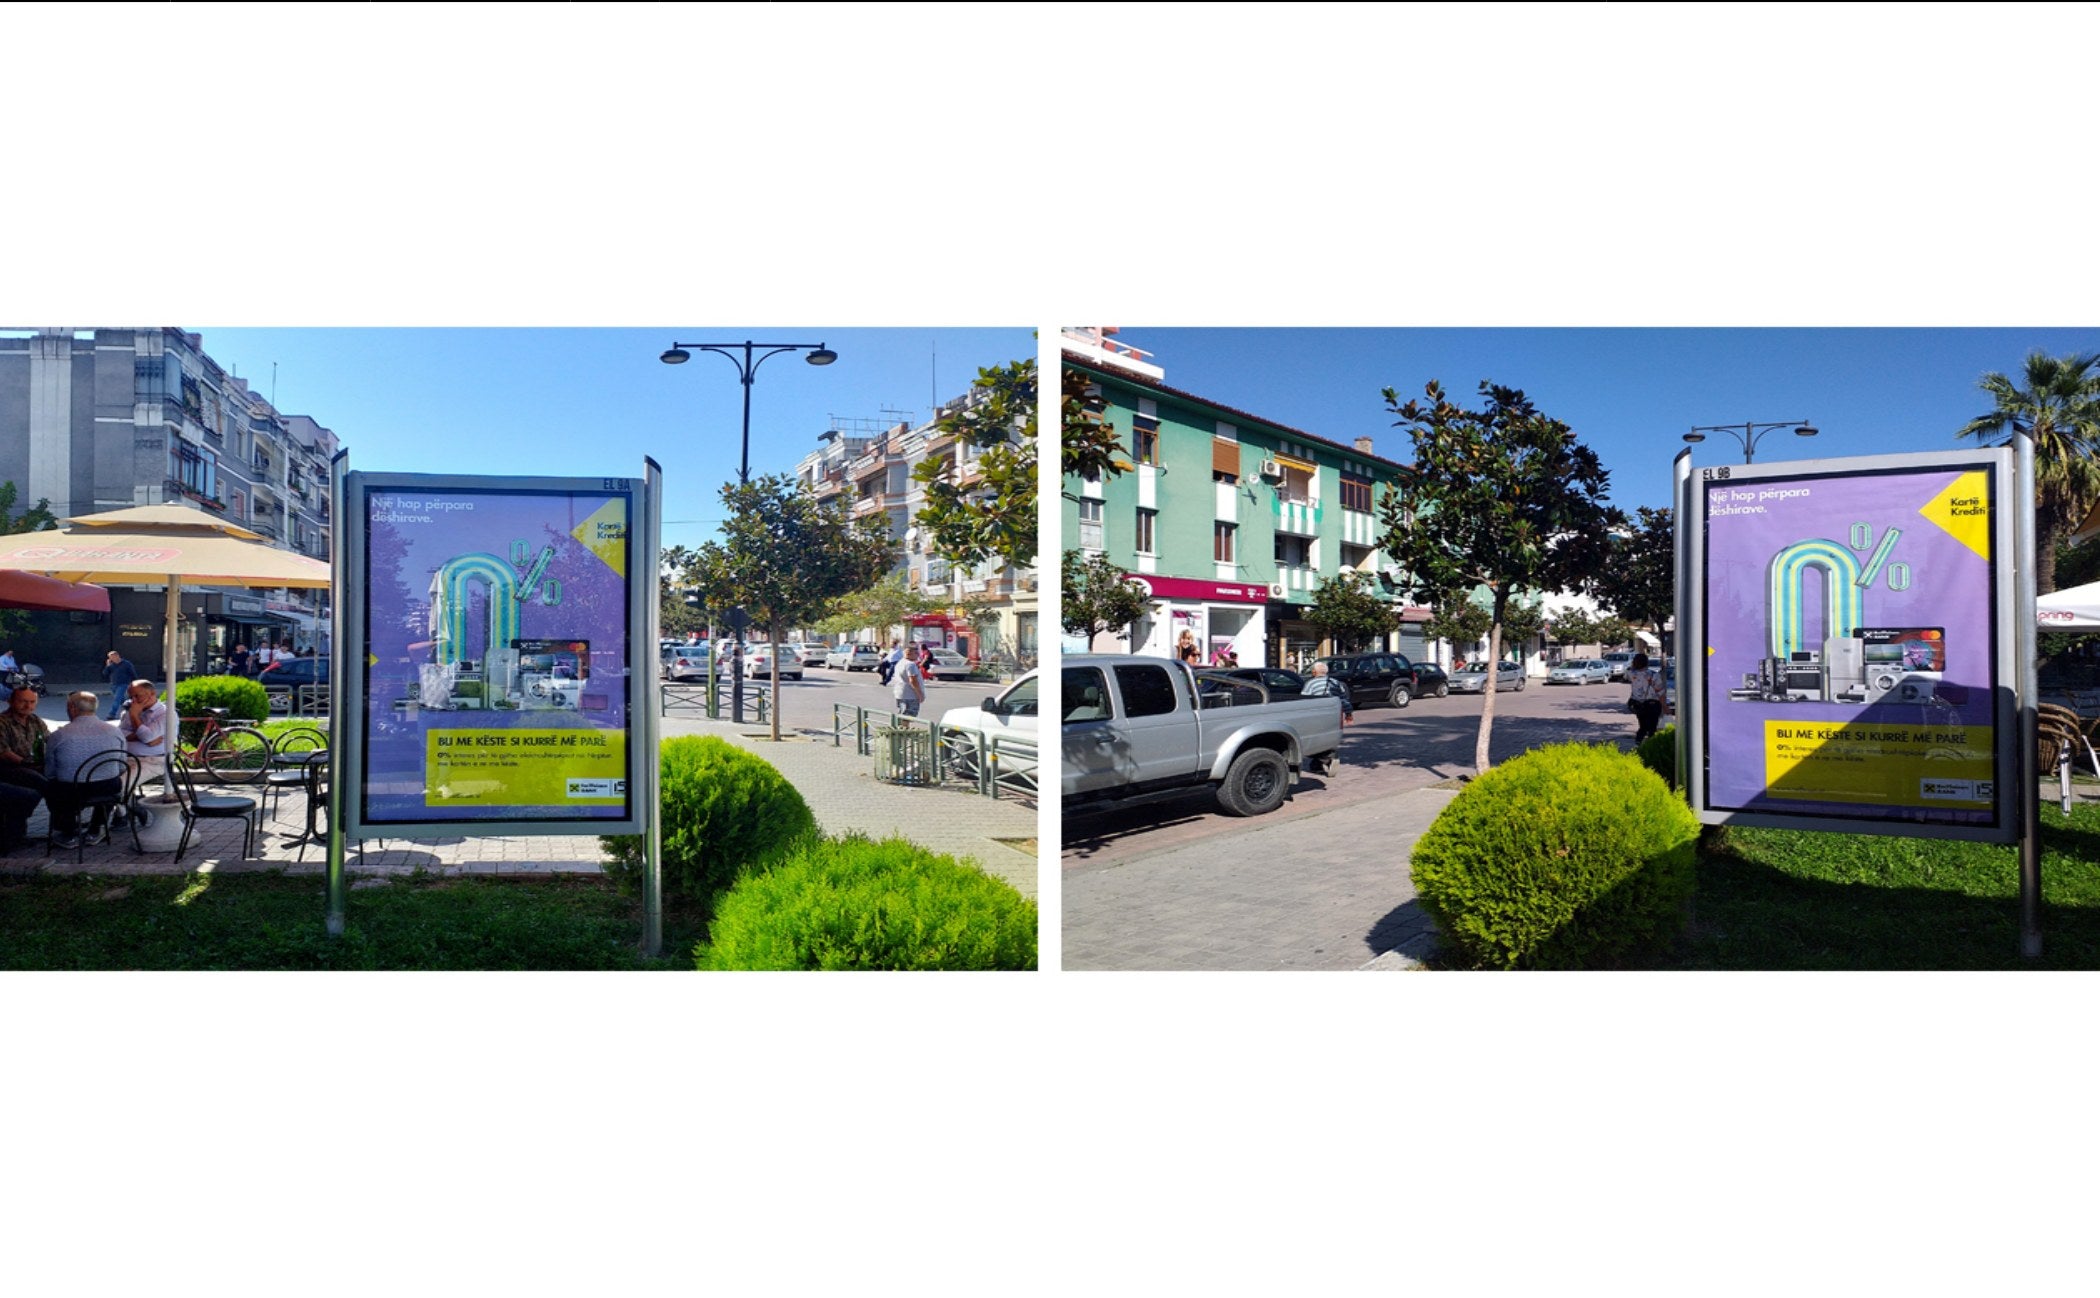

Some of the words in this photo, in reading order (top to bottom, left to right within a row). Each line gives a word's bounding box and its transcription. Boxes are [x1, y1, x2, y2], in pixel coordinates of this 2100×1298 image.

[1702, 468, 1714, 480] EL
[1717, 466, 1731, 479] 9B
[603, 478, 615, 490] EL
[1731, 489, 1756, 503] hap
[1759, 487, 1811, 502] përpara
[1951, 496, 1979, 506] Kartë
[397, 497, 422, 512] hap
[425, 498, 475, 513] përpara
[2037, 610, 2074, 622] pring
[456, 736, 473, 747] ME
[476, 735, 507, 747] KËSTE
[510, 737, 520, 747] SI
[523, 735, 557, 747] KURRË
[561, 735, 577, 747] MË
[1776, 729, 1793, 739] BLI
[1796, 729, 1814, 740] ME
[1818, 728, 1850, 741] KËSTE
[1855, 731, 1866, 741] SI
[1870, 730, 1909, 743] KURRË
